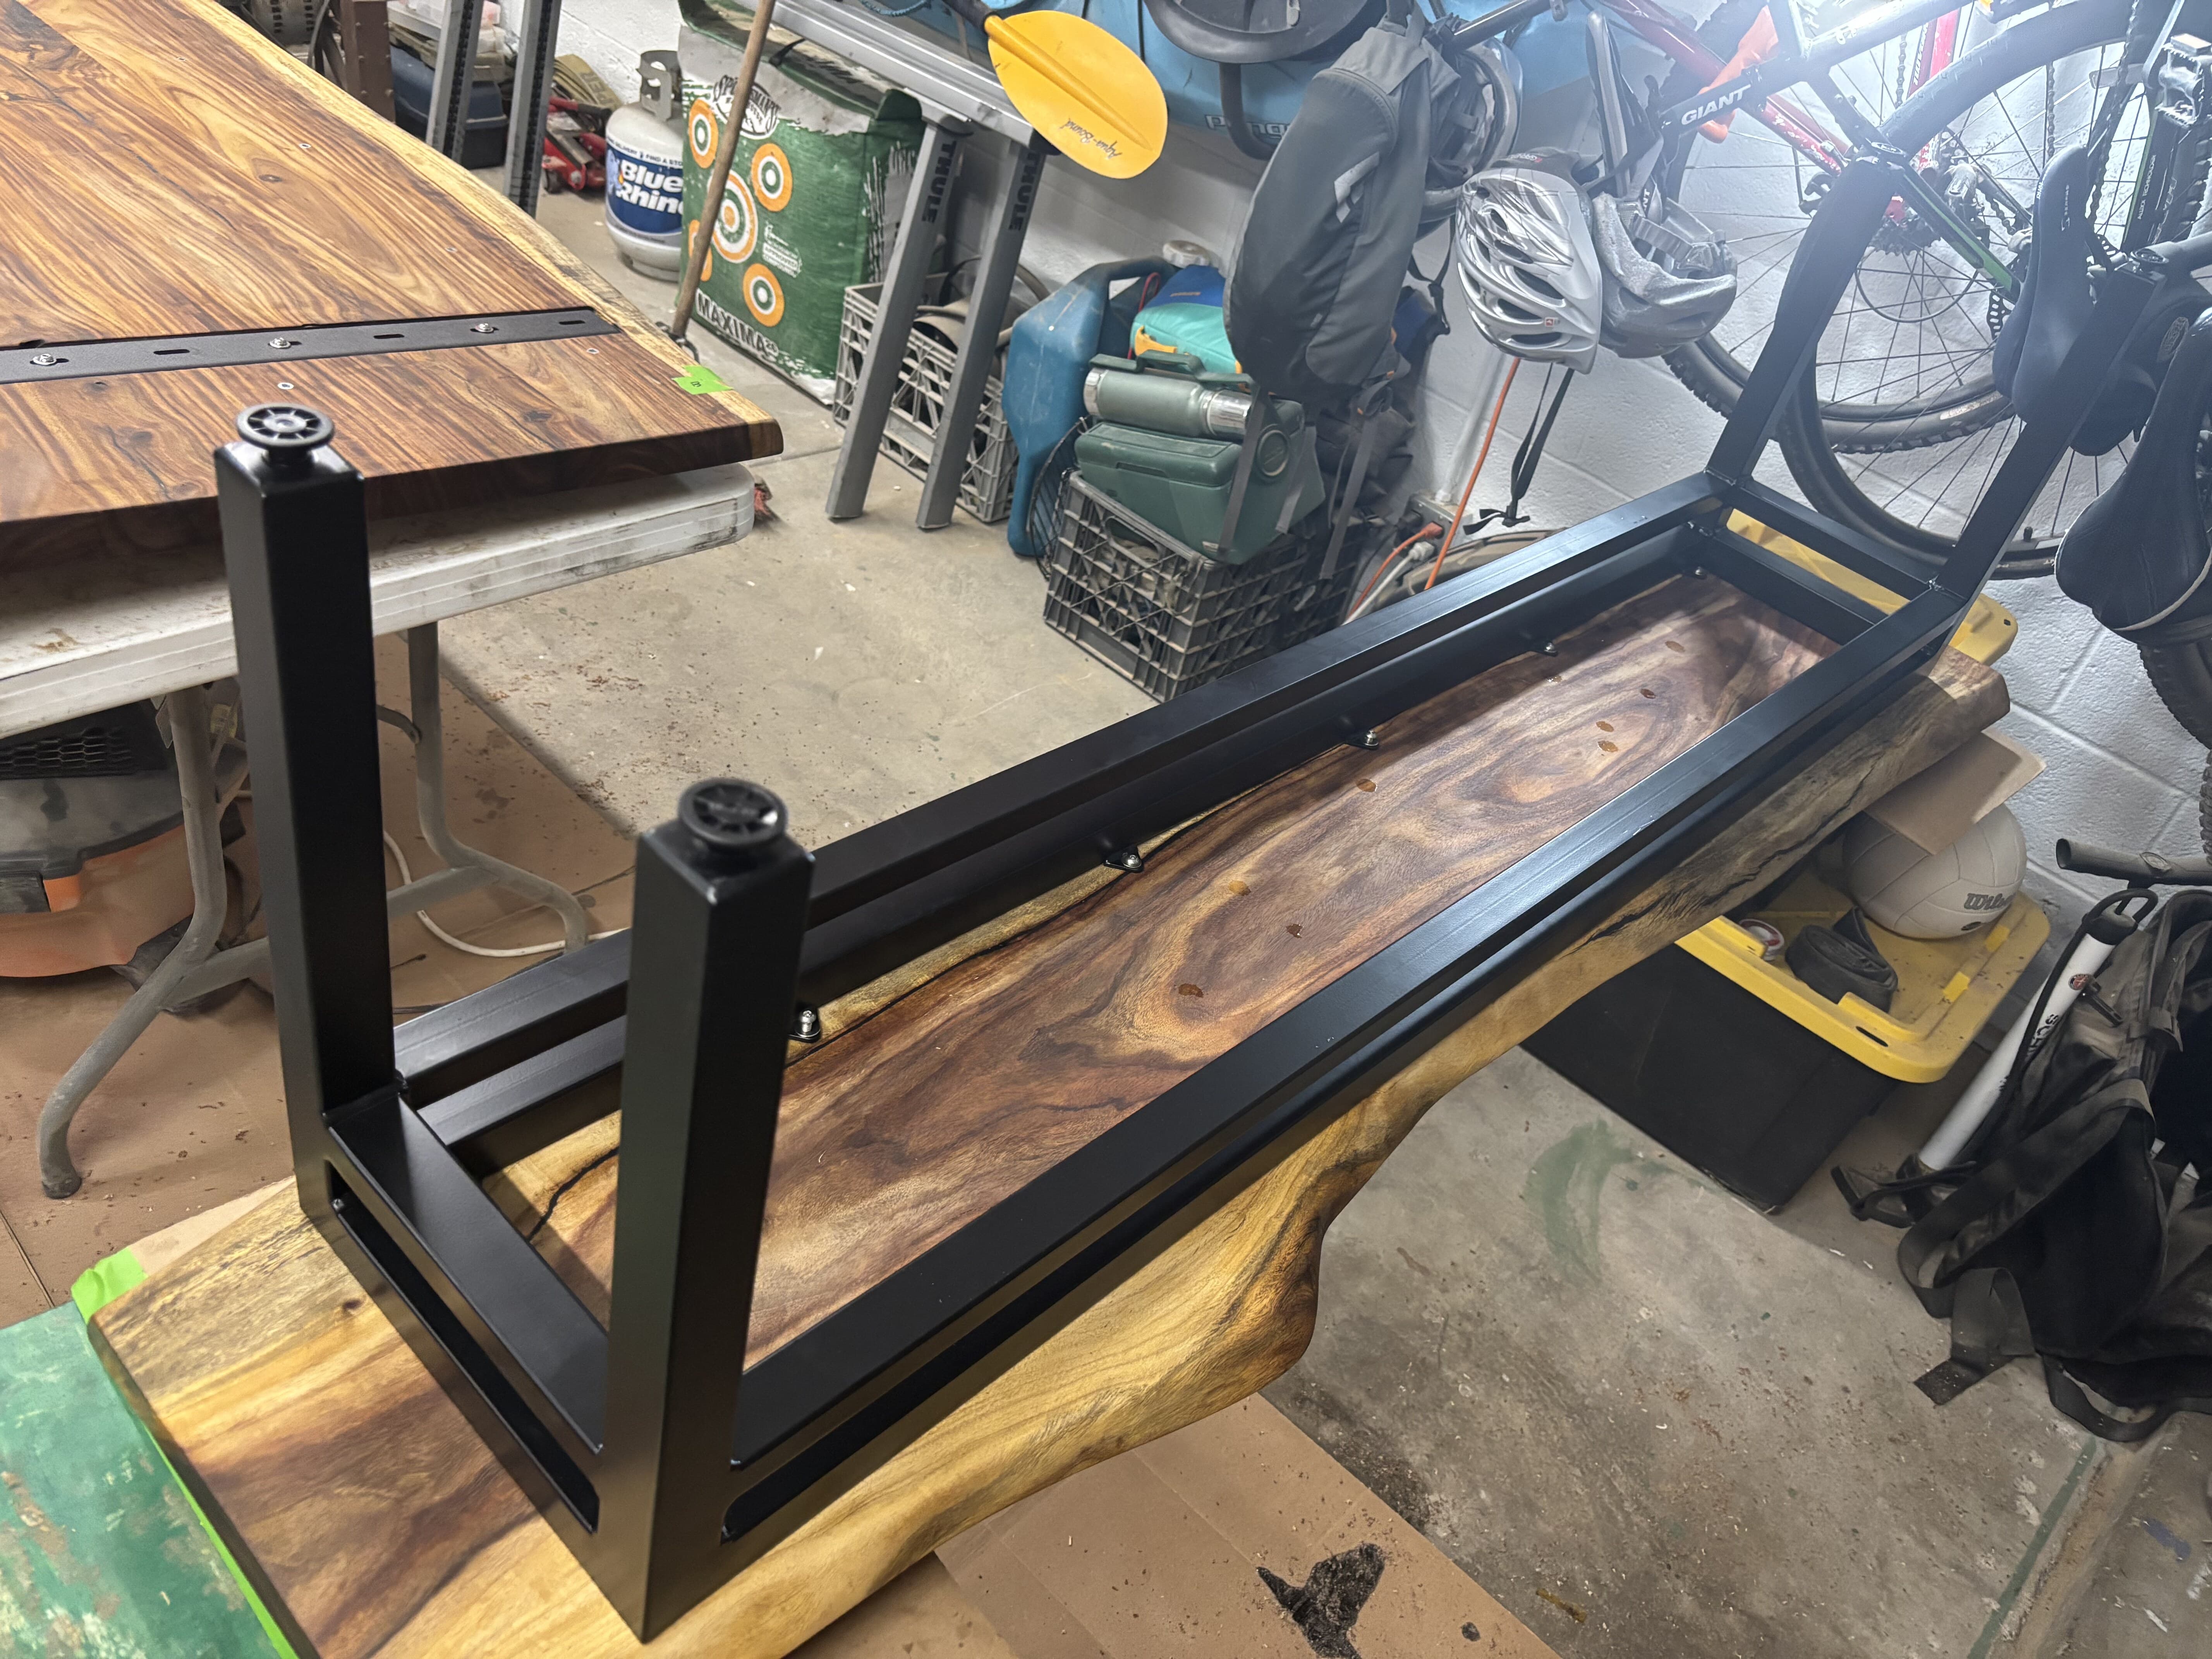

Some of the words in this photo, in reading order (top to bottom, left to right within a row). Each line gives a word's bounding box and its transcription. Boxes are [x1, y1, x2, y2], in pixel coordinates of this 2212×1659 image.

[1681, 84, 1751, 125] GIANT
[1205, 115, 1291, 139] png
[621, 159, 684, 193] Blue
[922, 141, 957, 223] THULE
[1008, 149, 1042, 231] THULE
[696, 290, 769, 358] MAXIMA
[1964, 893, 2016, 910] Wils
